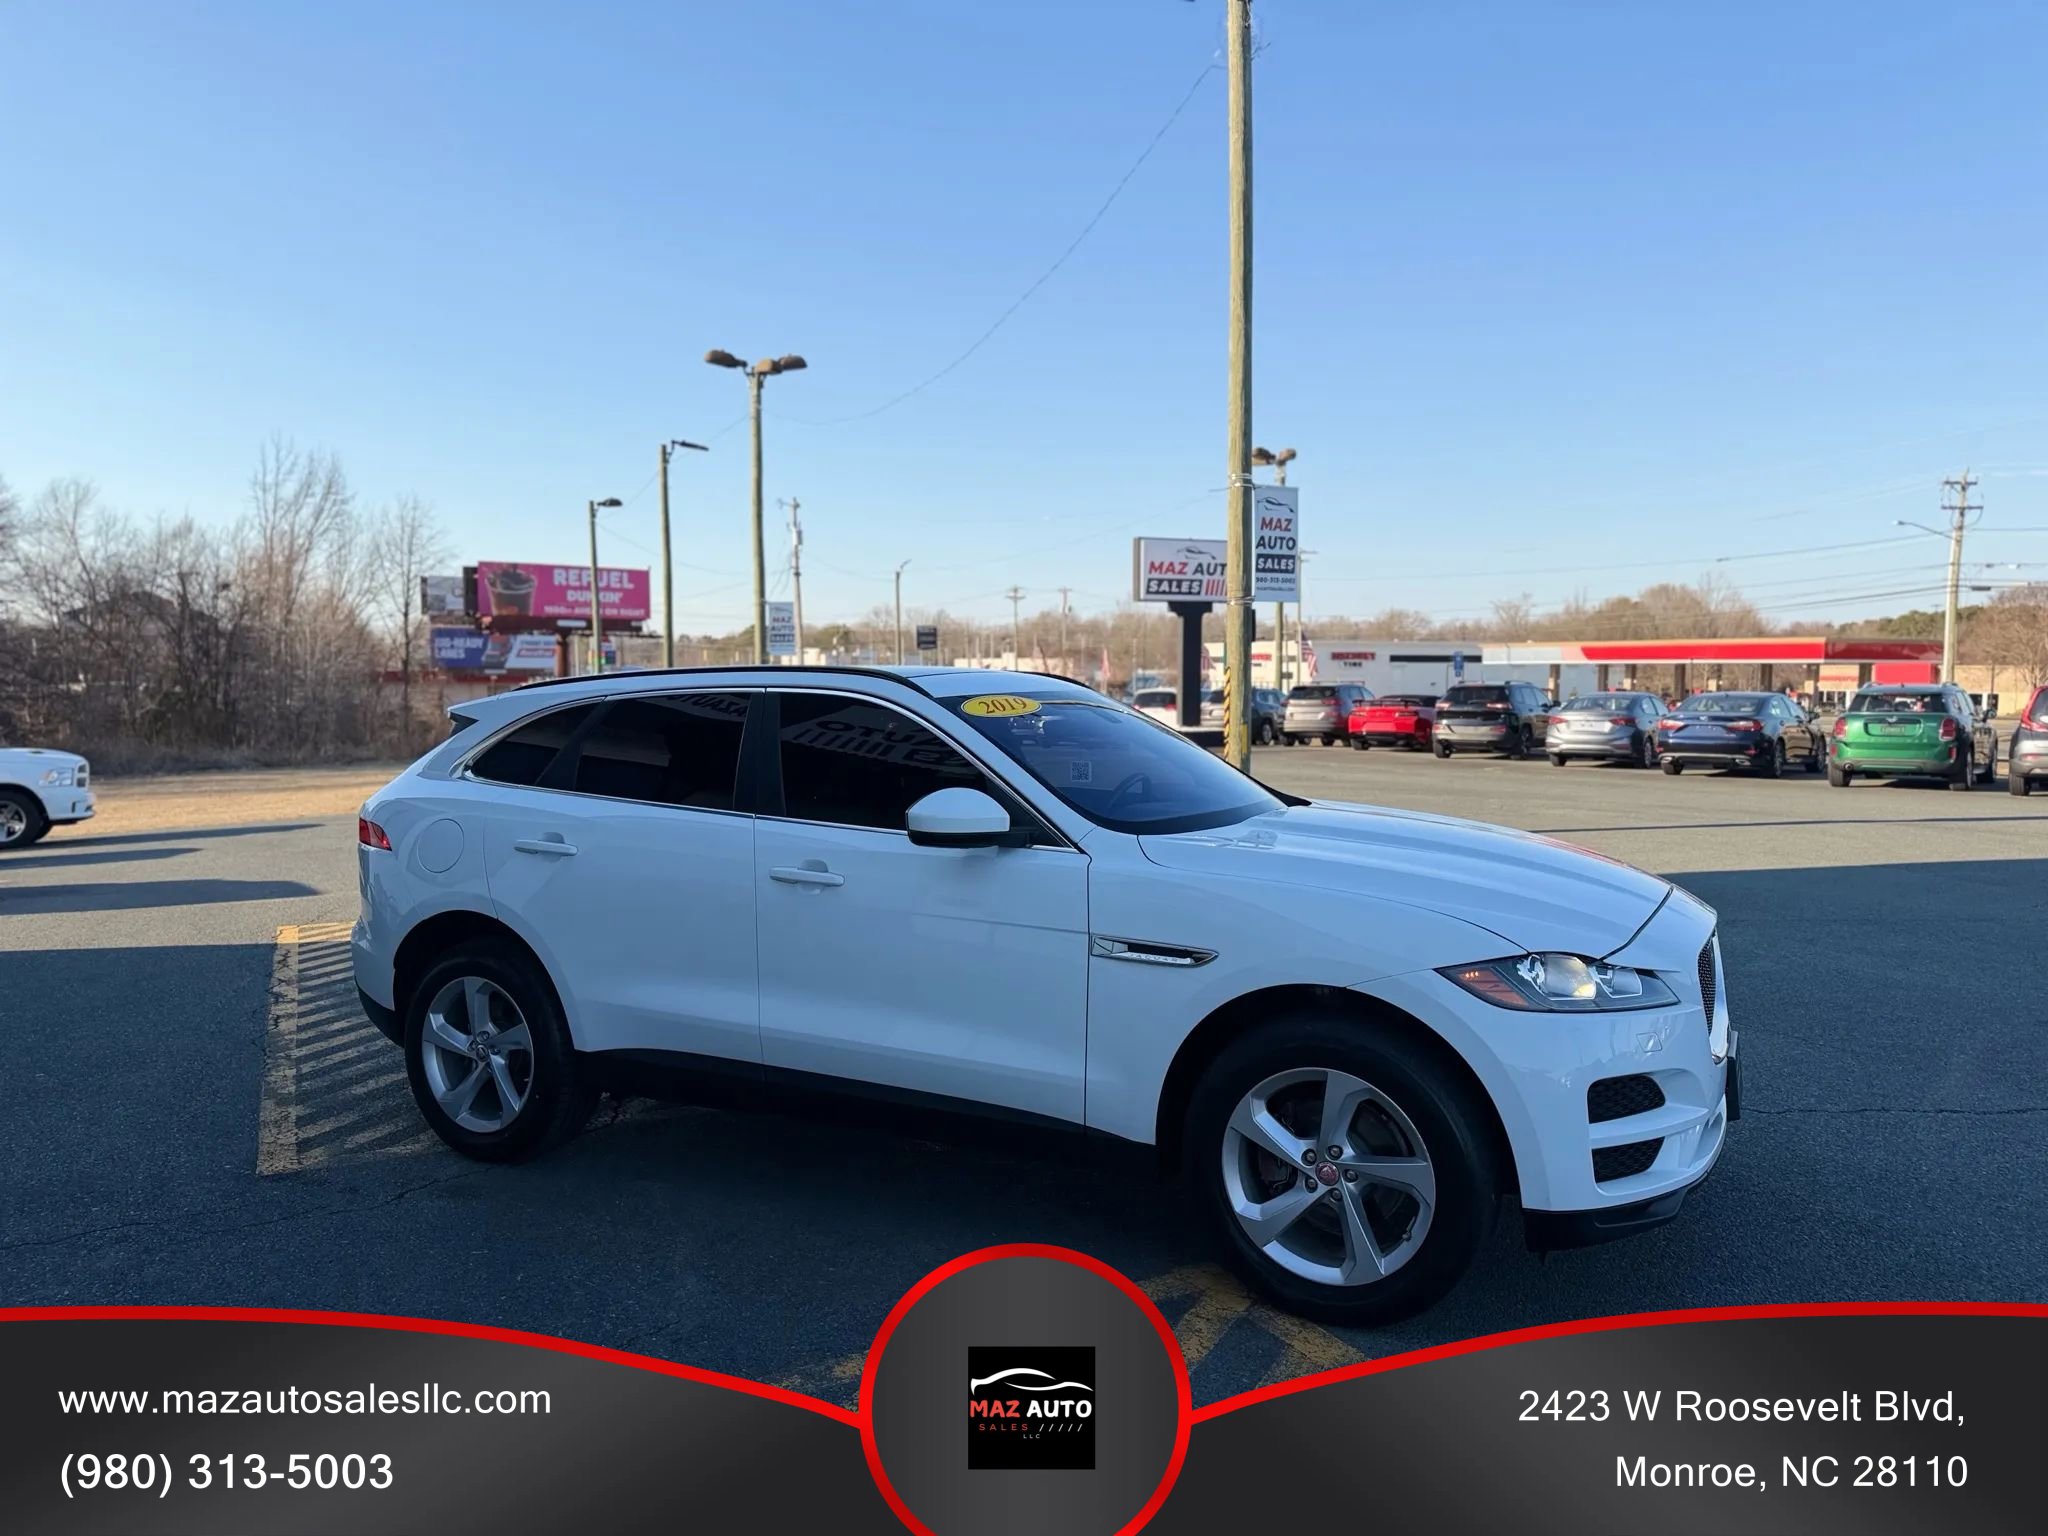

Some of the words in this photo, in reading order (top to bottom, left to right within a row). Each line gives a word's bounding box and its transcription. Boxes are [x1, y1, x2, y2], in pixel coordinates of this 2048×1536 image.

[1260, 517, 1293, 532] MAZ
[1256, 535, 1296, 551] AUTO
[1149, 560, 1188, 575] MAZ
[1192, 562, 1227, 576] AUT
[1257, 557, 1294, 570] SALES
[553, 568, 635, 589] REFUEL
[1148, 580, 1200, 593] SALES
[978, 696, 1028, 714] 2019
